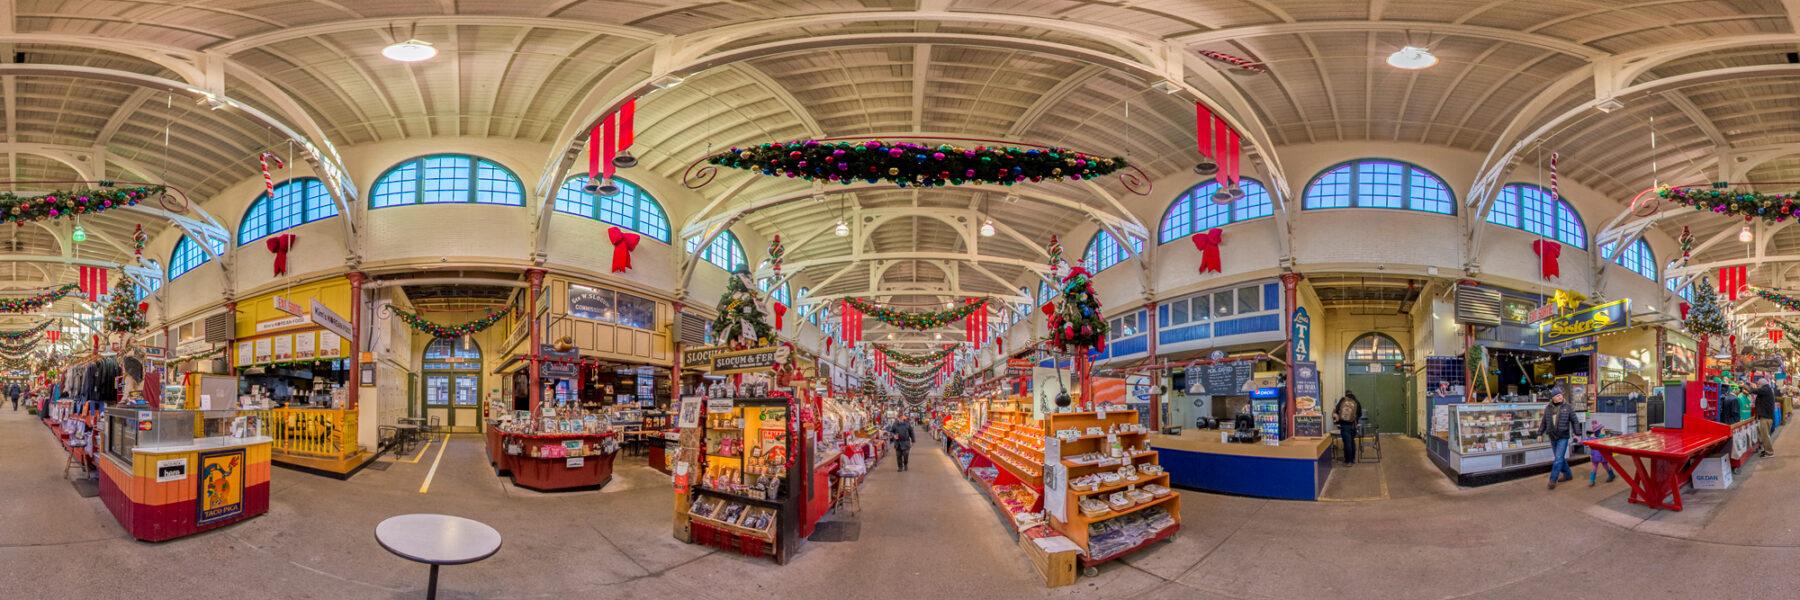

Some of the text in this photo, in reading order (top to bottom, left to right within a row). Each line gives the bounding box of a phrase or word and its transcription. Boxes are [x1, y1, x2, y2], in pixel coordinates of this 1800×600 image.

[1529, 311, 1539, 322] EXIT
[1538, 304, 1553, 319] SORTIE
[1563, 344, 1594, 354] Italian Foods
[716, 356, 747, 367] SLOCUM
[205, 504, 239, 518] TACO PICA
